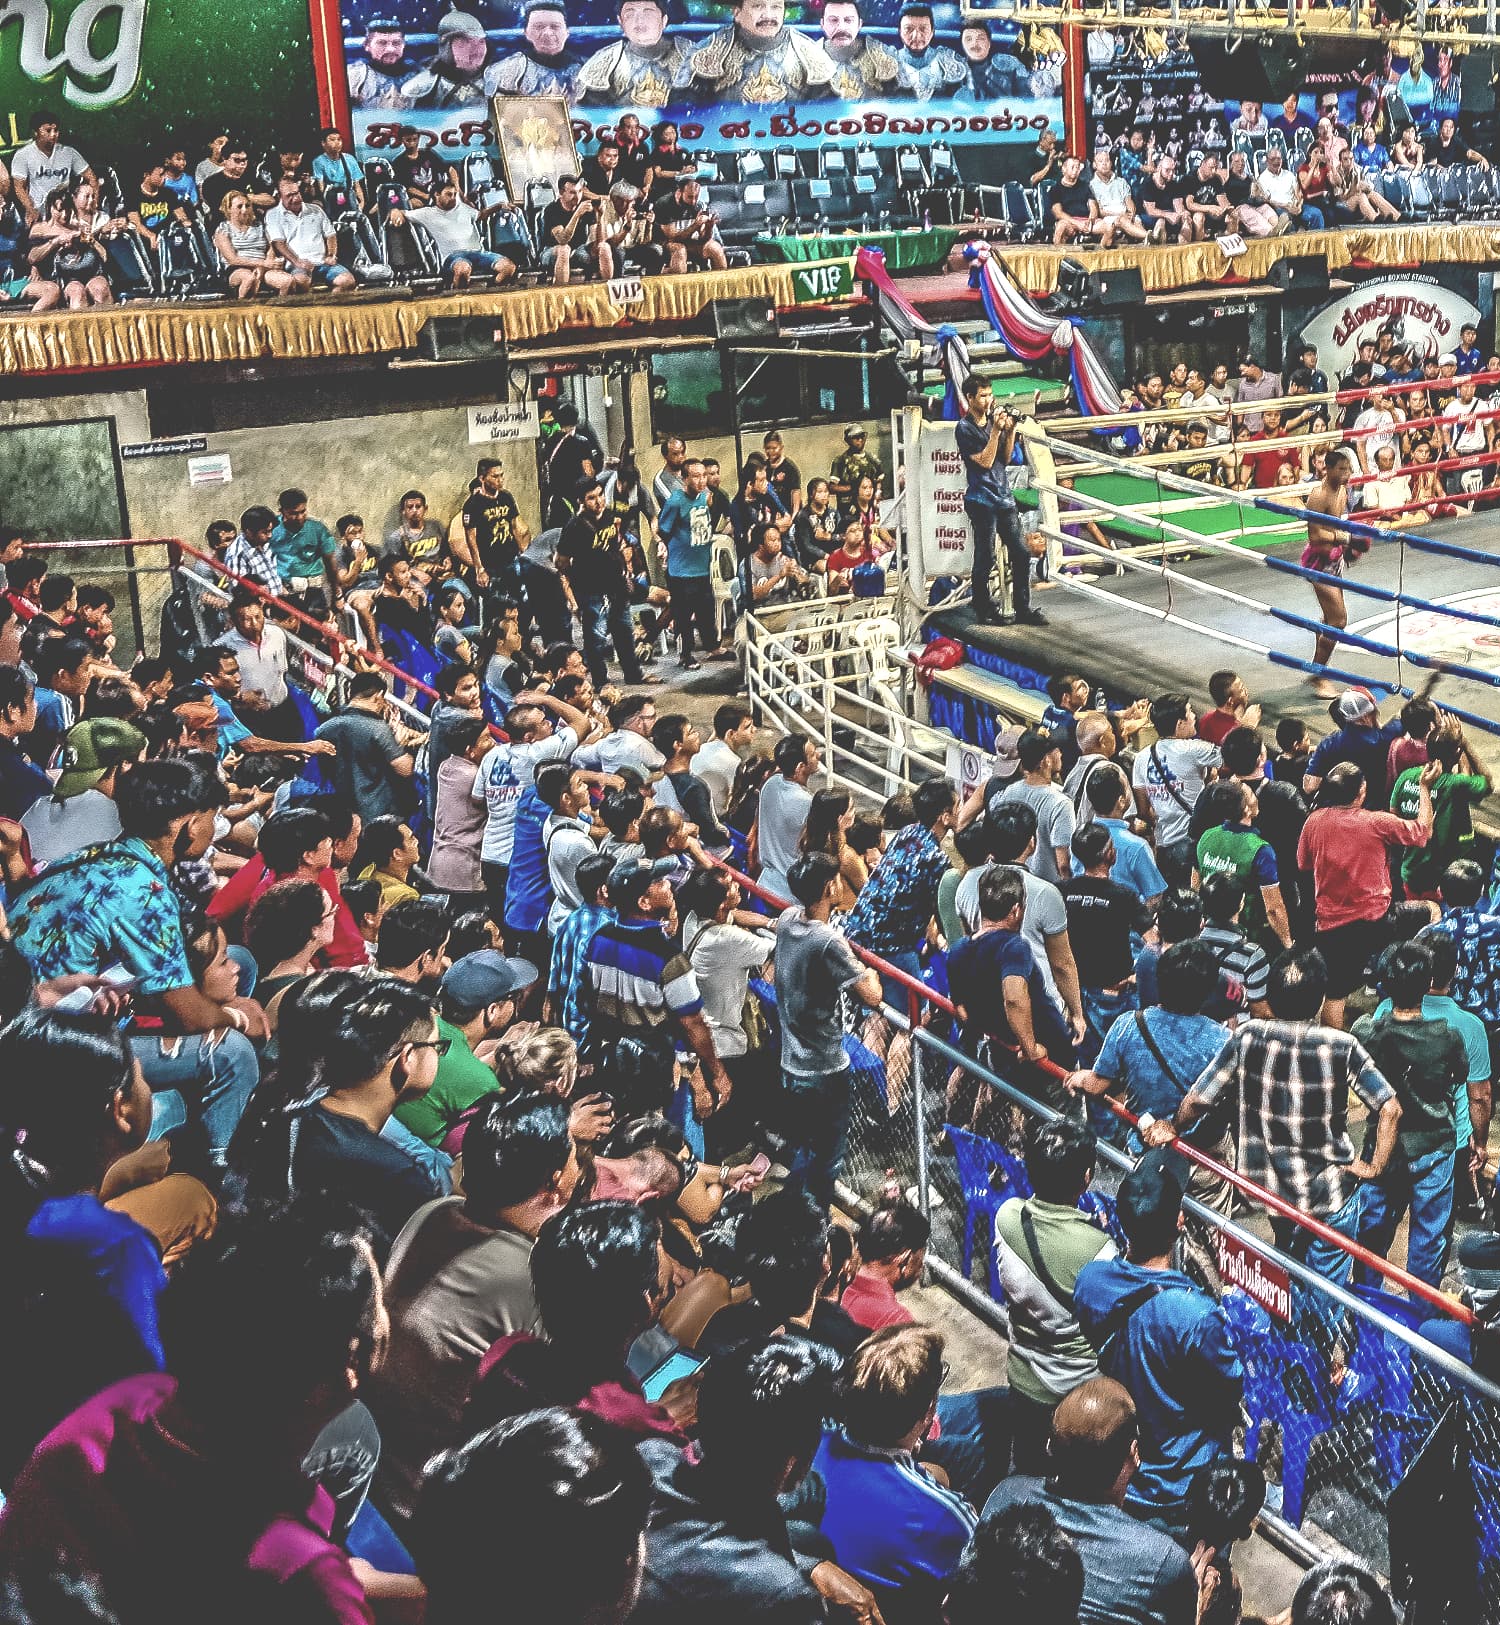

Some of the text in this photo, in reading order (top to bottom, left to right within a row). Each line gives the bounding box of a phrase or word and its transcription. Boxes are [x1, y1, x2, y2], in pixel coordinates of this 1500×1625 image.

[1220, 236, 1242, 251] VIP
[798, 265, 842, 298] VIP
[612, 282, 641, 300] VIP
